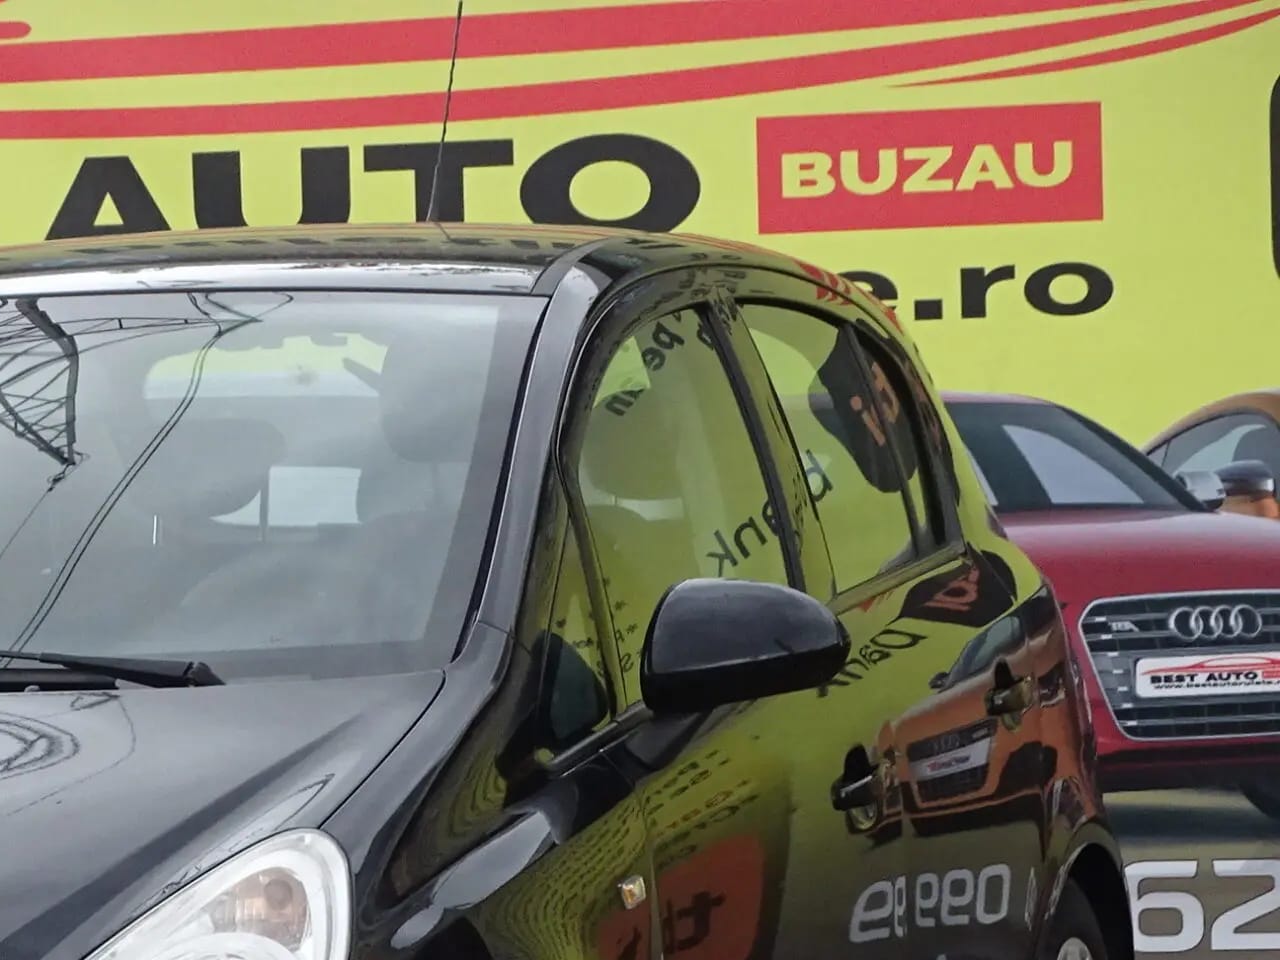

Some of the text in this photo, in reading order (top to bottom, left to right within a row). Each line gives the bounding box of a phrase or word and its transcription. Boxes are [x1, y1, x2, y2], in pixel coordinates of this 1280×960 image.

[43, 131, 702, 242] AUTO
[780, 139, 1075, 199] BUZAU
[1150, 673, 1198, 685] BEST
[1205, 671, 1258, 682] AUTO
[1124, 858, 1280, 952] 62
